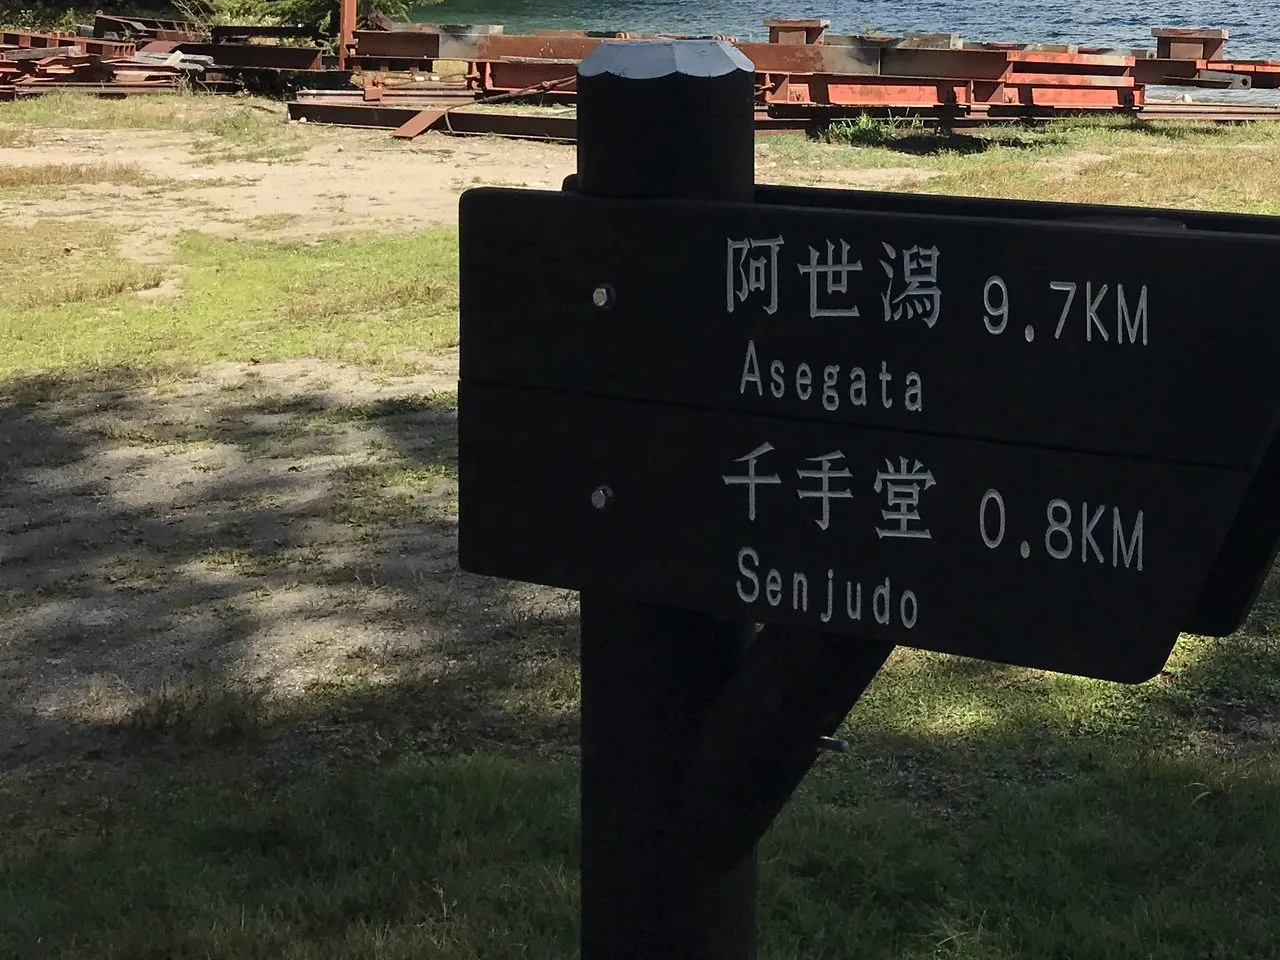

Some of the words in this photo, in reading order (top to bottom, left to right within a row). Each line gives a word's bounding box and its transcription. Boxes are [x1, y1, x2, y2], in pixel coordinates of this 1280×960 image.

[726, 234, 942, 329] 阿世潟
[982, 275, 1149, 346] 9.7KM
[739, 339, 923, 412] Asegata
[722, 441, 937, 539] 千手堂
[979, 488, 1144, 571] 0.8KM
[736, 546, 918, 629] Senjudo
